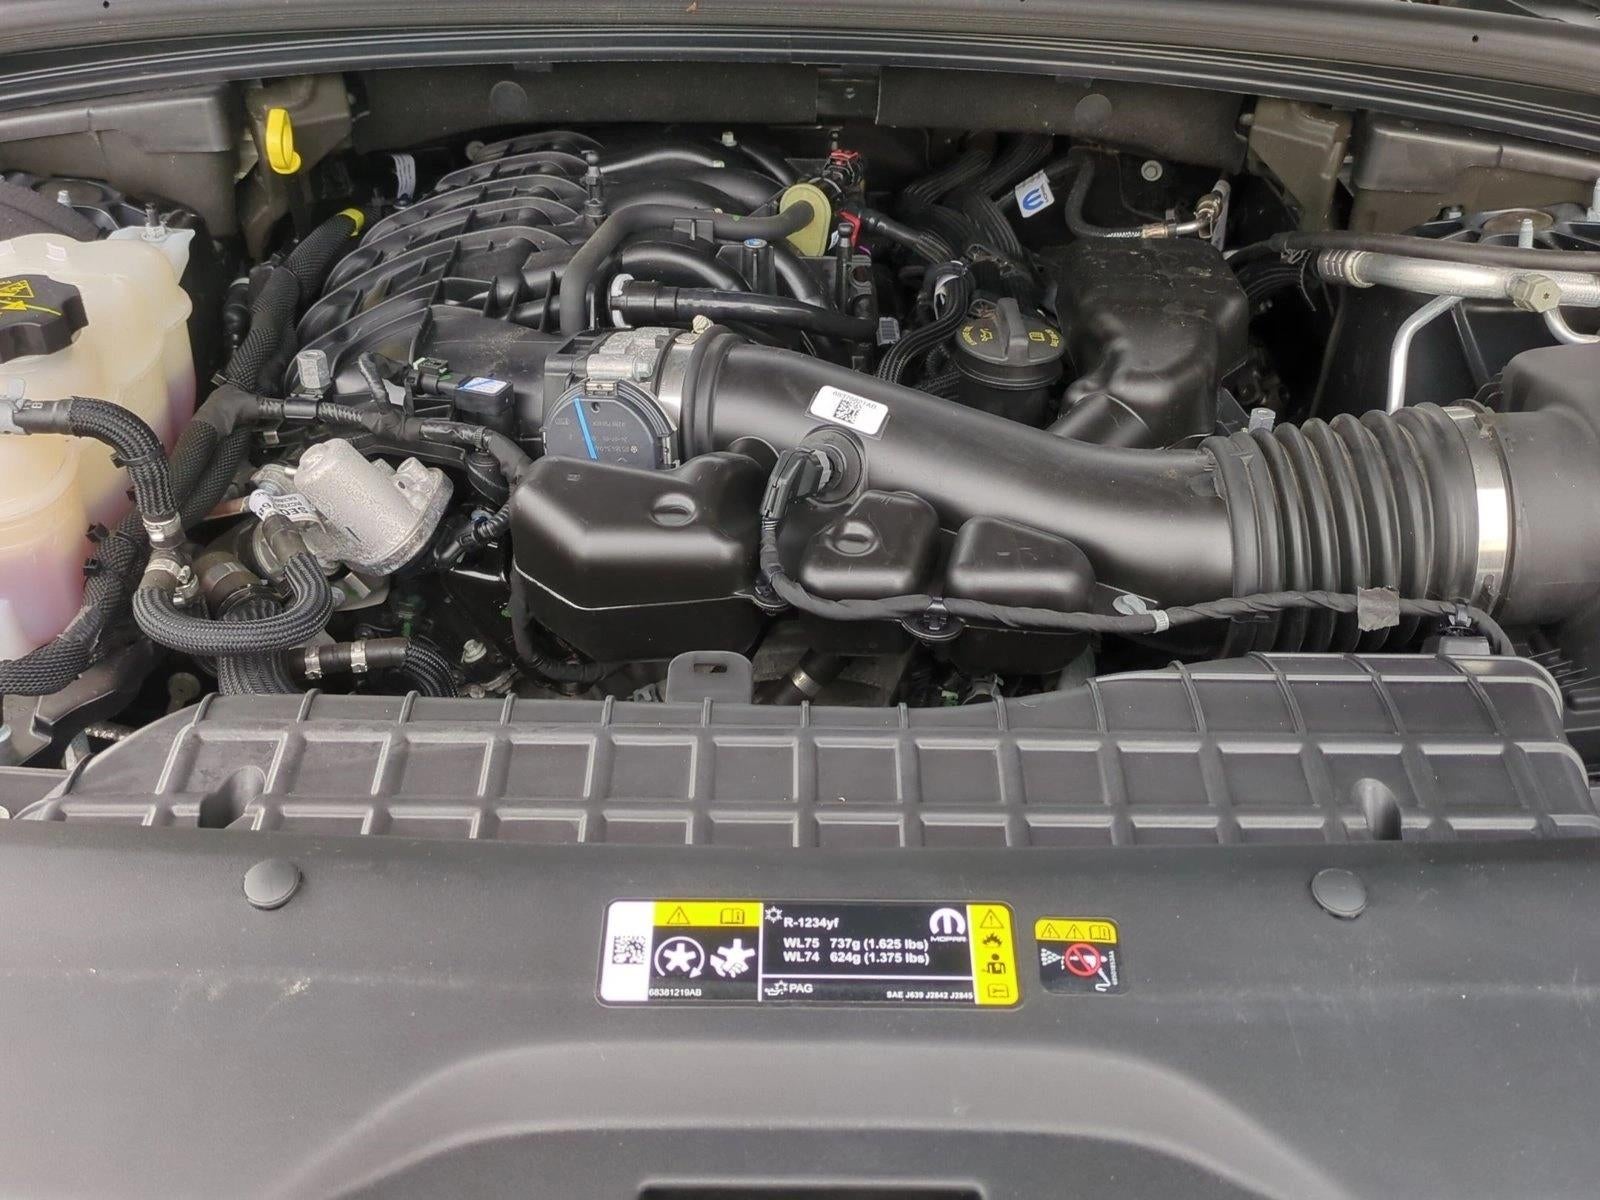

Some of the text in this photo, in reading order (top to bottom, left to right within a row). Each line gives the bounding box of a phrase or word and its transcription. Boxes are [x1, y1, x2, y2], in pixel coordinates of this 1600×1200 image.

[783, 917, 840, 930] R-1234yf
[783, 937, 929, 952] WL75 737g (1.625 lbs)
[783, 951, 930, 966] WL74 624g (1.375 lbs)
[788, 983, 814, 994] PAG
[886, 991, 904, 999] SAE
